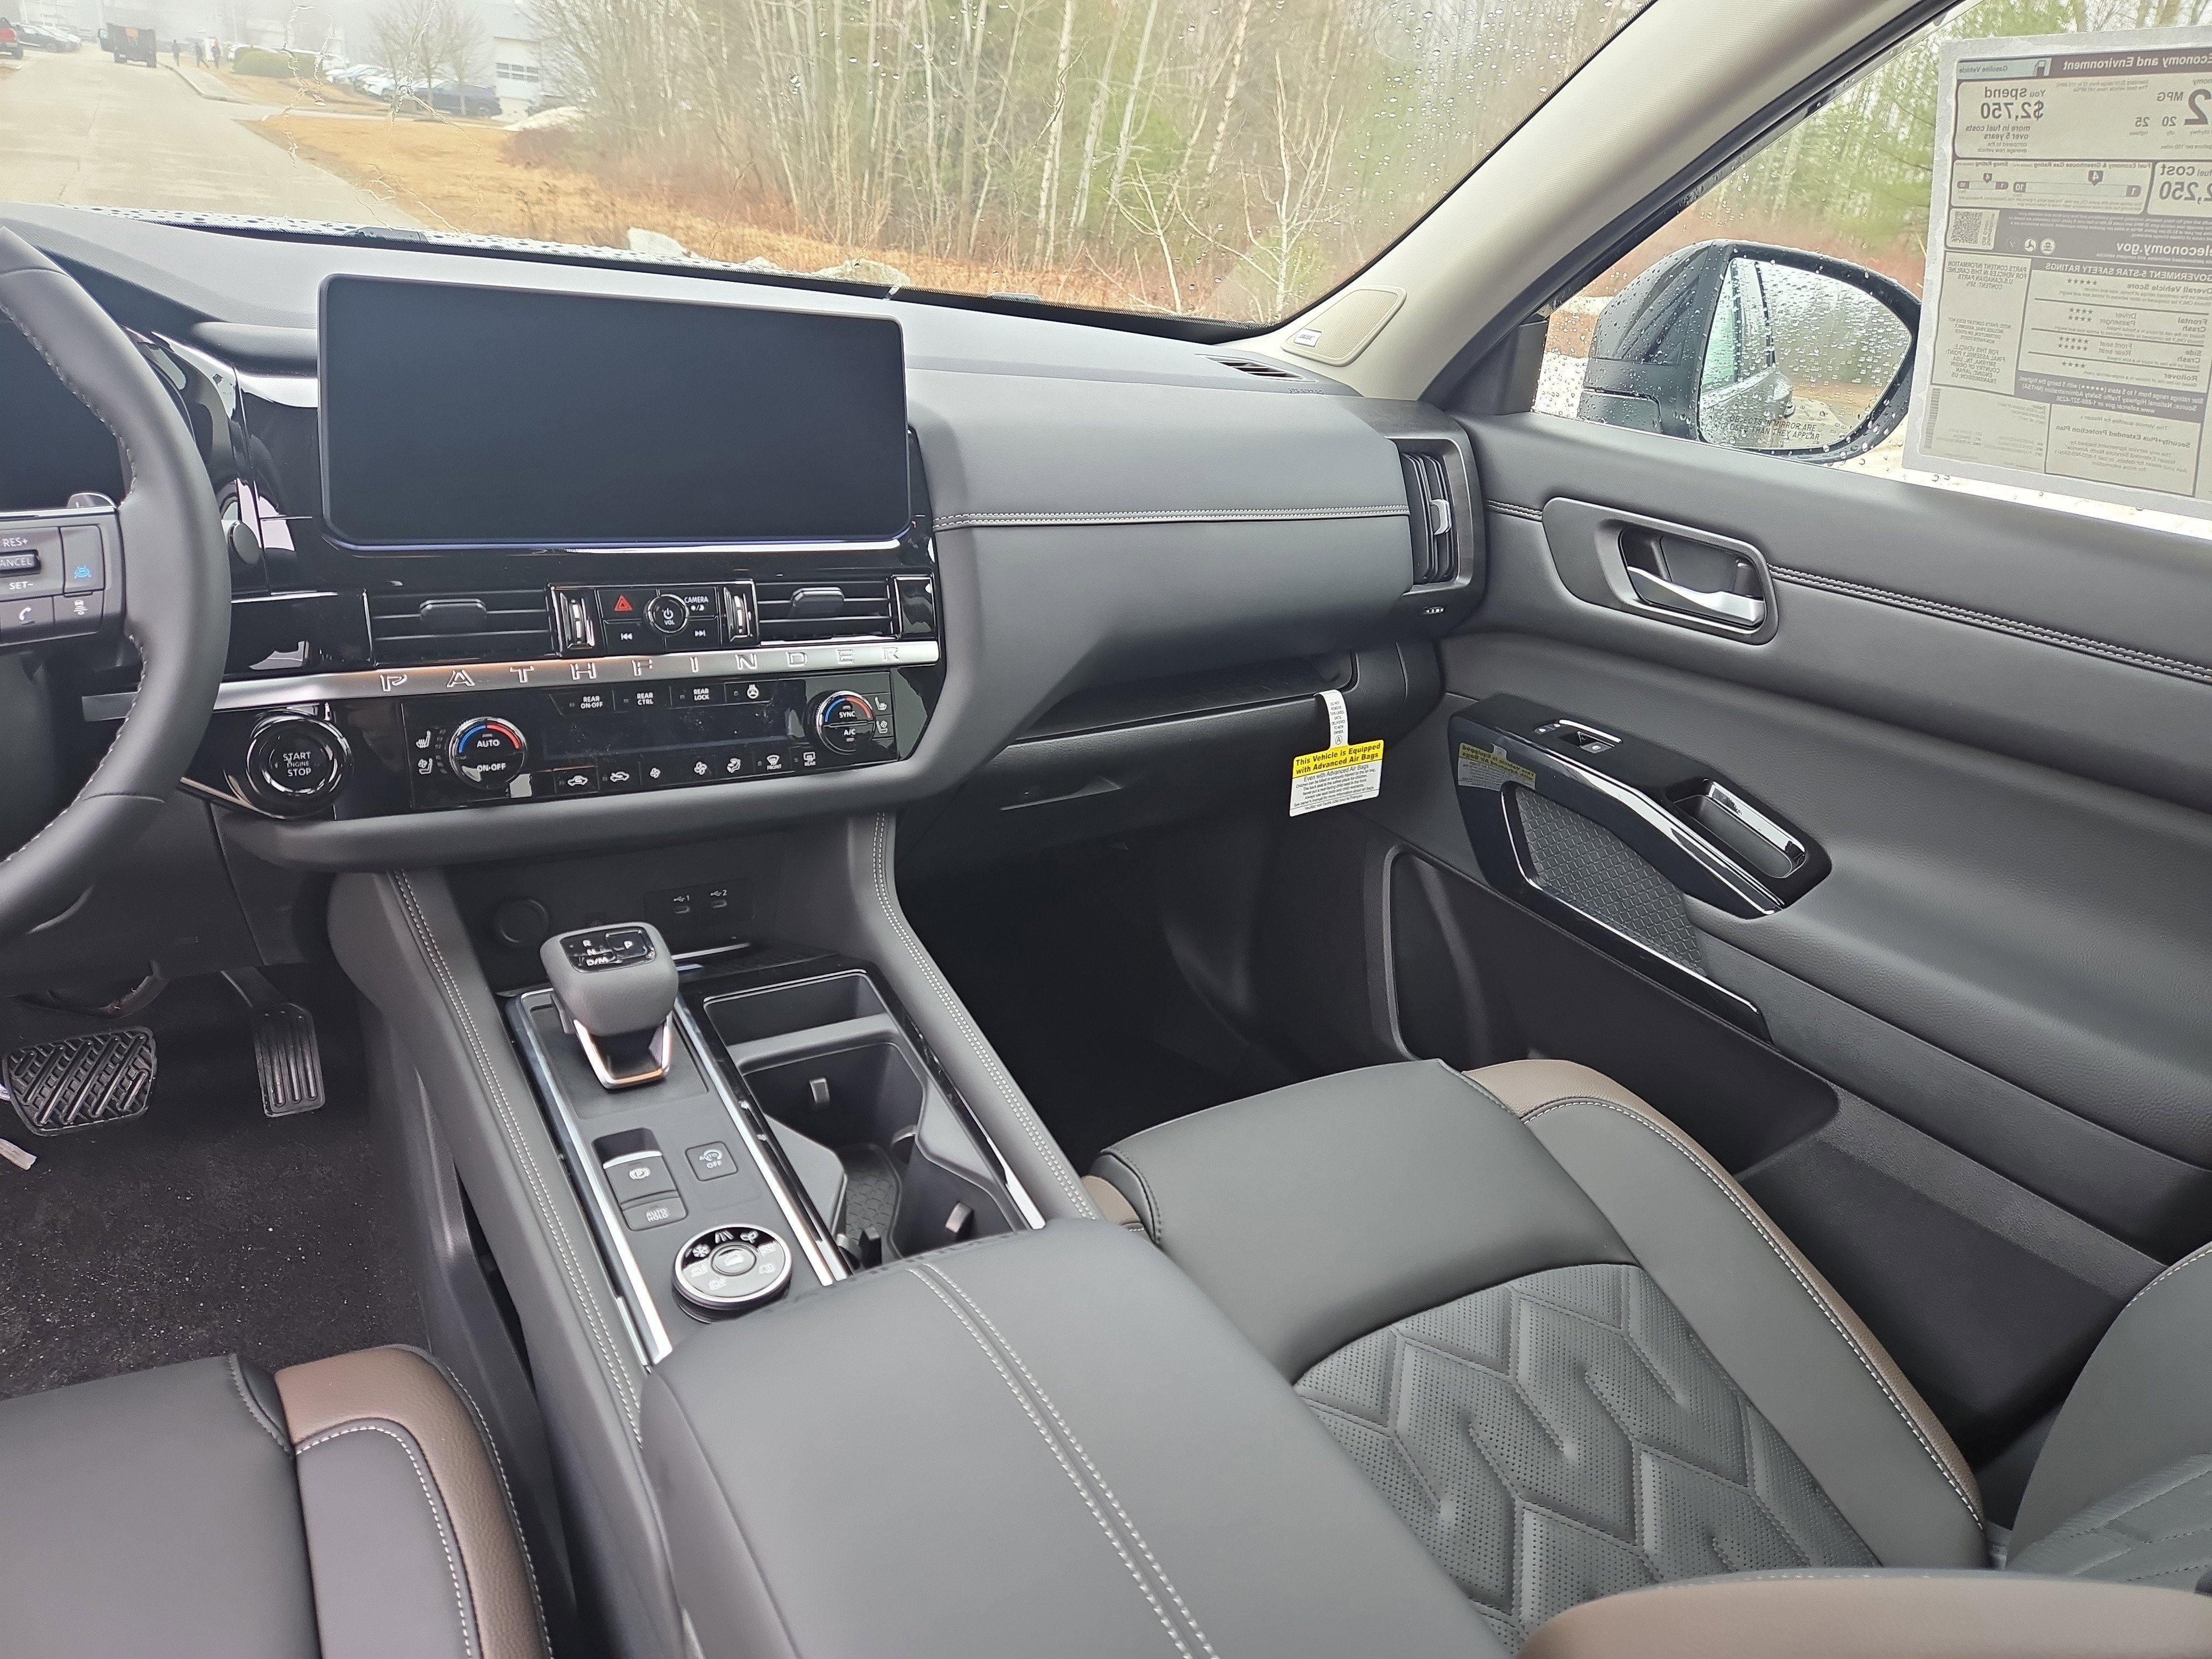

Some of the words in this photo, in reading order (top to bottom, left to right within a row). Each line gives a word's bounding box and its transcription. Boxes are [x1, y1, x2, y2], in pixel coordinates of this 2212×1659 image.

[1773, 420, 1802, 429] MIRROR
[1802, 424, 1817, 432] ARE
[1751, 426, 1770, 434] THAN
[1773, 428, 1790, 437] THEY
[2, 537, 28, 547] RES+
[0, 557, 33, 567] ANCEL
[380, 647, 899, 692] PATHFINDER
[583, 695, 600, 703] REAR
[636, 692, 654, 700] REAR
[844, 728, 856, 736] A/C
[477, 738, 500, 748] AUTO
[282, 751, 311, 762] START
[1296, 757, 1310, 766] This
[1313, 751, 1338, 762] Vehicle
[1348, 742, 1381, 755] Equipped
[1296, 766, 1311, 775] with
[1313, 758, 1347, 771] Advanced
[1348, 755, 1359, 763] Air
[1361, 752, 1379, 761] Bags
[287, 768, 312, 777] STOP
[1326, 767, 1349, 777] Advanced
[1358, 763, 1369, 771] Bags
[623, 940, 633, 949] P
[586, 956, 609, 967] D/M
[706, 1160, 722, 1169] OFF
[646, 1208, 667, 1217] AUTO
